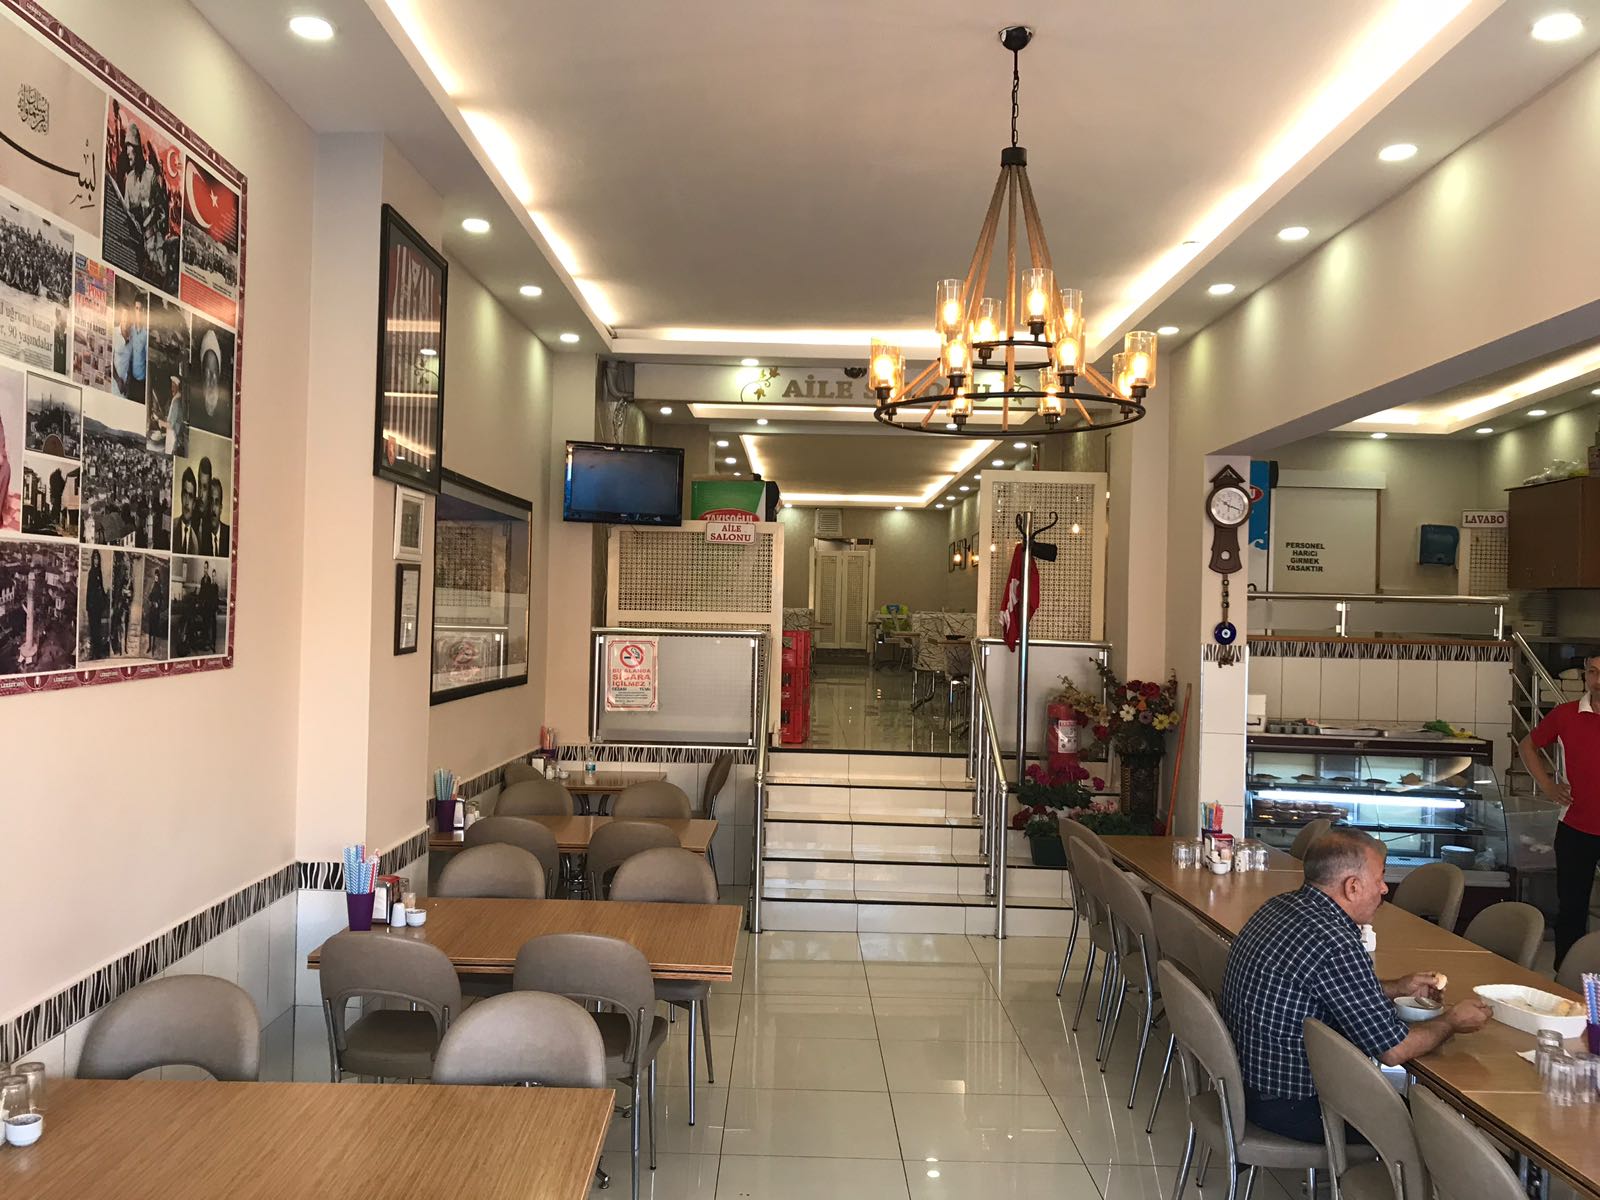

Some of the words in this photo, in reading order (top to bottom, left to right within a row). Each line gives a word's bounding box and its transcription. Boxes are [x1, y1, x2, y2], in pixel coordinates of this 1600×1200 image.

[782, 374, 854, 400] AİLE
[1464, 514, 1505, 524] LAVABO
[721, 523, 742, 532] AİLE
[710, 532, 752, 542] SALONU
[1285, 542, 1325, 550] PERSONEL
